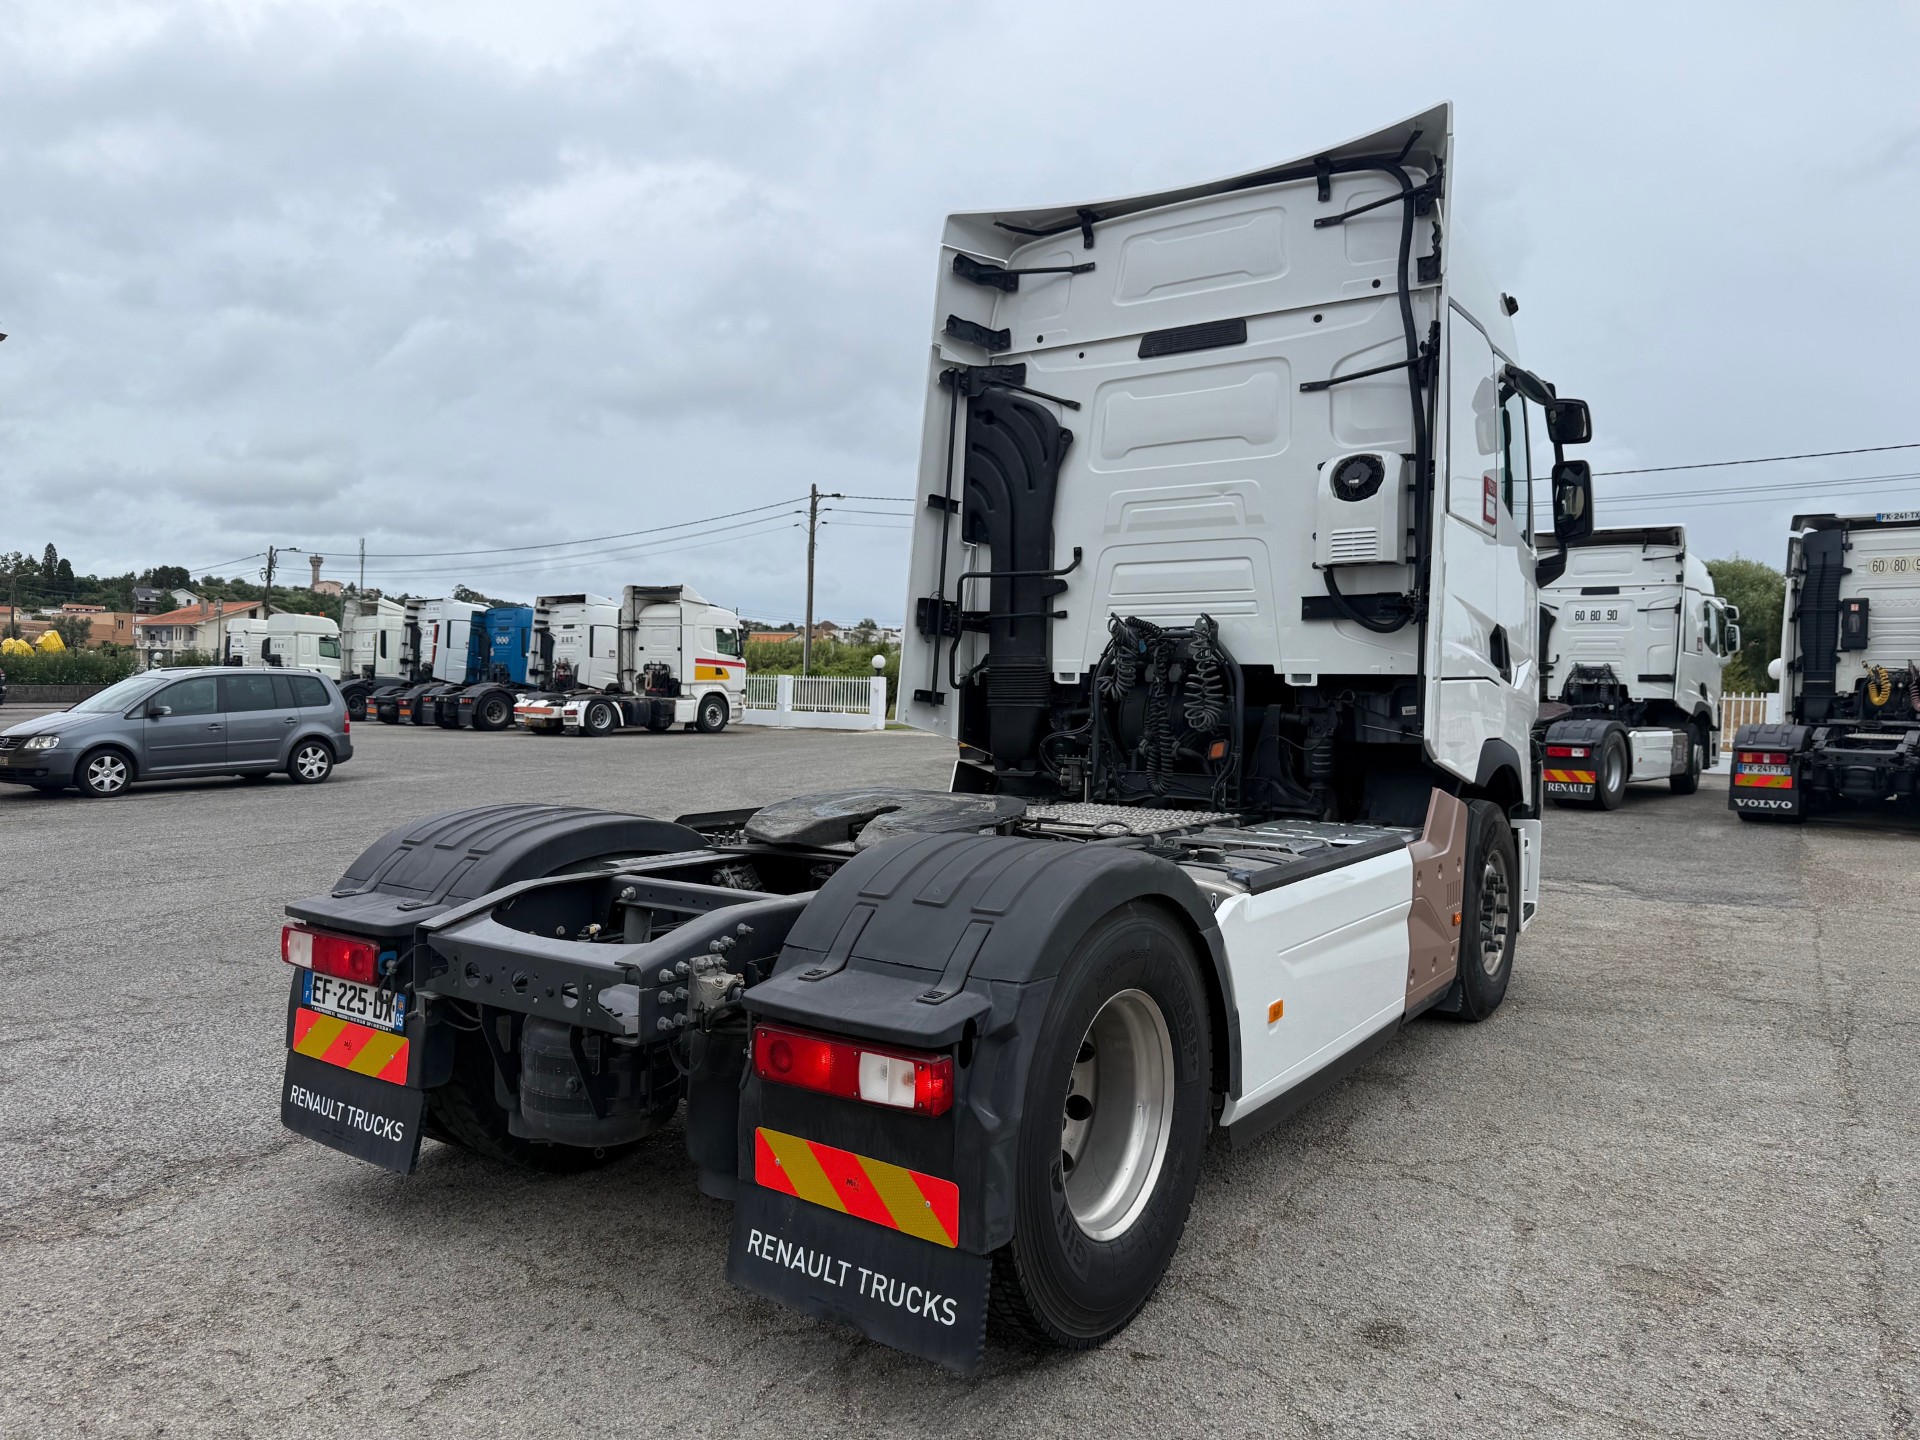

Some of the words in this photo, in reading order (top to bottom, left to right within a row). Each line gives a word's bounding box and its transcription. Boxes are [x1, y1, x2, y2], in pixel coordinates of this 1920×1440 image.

[1881, 511, 1920, 520] FK-241-TX
[1872, 560, 1884, 573] 60
[1894, 559, 1906, 572] 80
[1574, 610, 1585, 621] 60
[1590, 610, 1601, 621] 80
[1606, 609, 1618, 621] 90
[1743, 764, 1785, 773] FK-241-TX
[1547, 782, 1593, 794] RENAULT
[1734, 798, 1793, 809] VOLVO
[395, 1013, 404, 1027] 05
[290, 1084, 346, 1122] RENAULT
[347, 1105, 405, 1142] TRUCKS
[747, 1228, 852, 1288] RENAULT
[858, 1266, 957, 1327] TRUCKS
